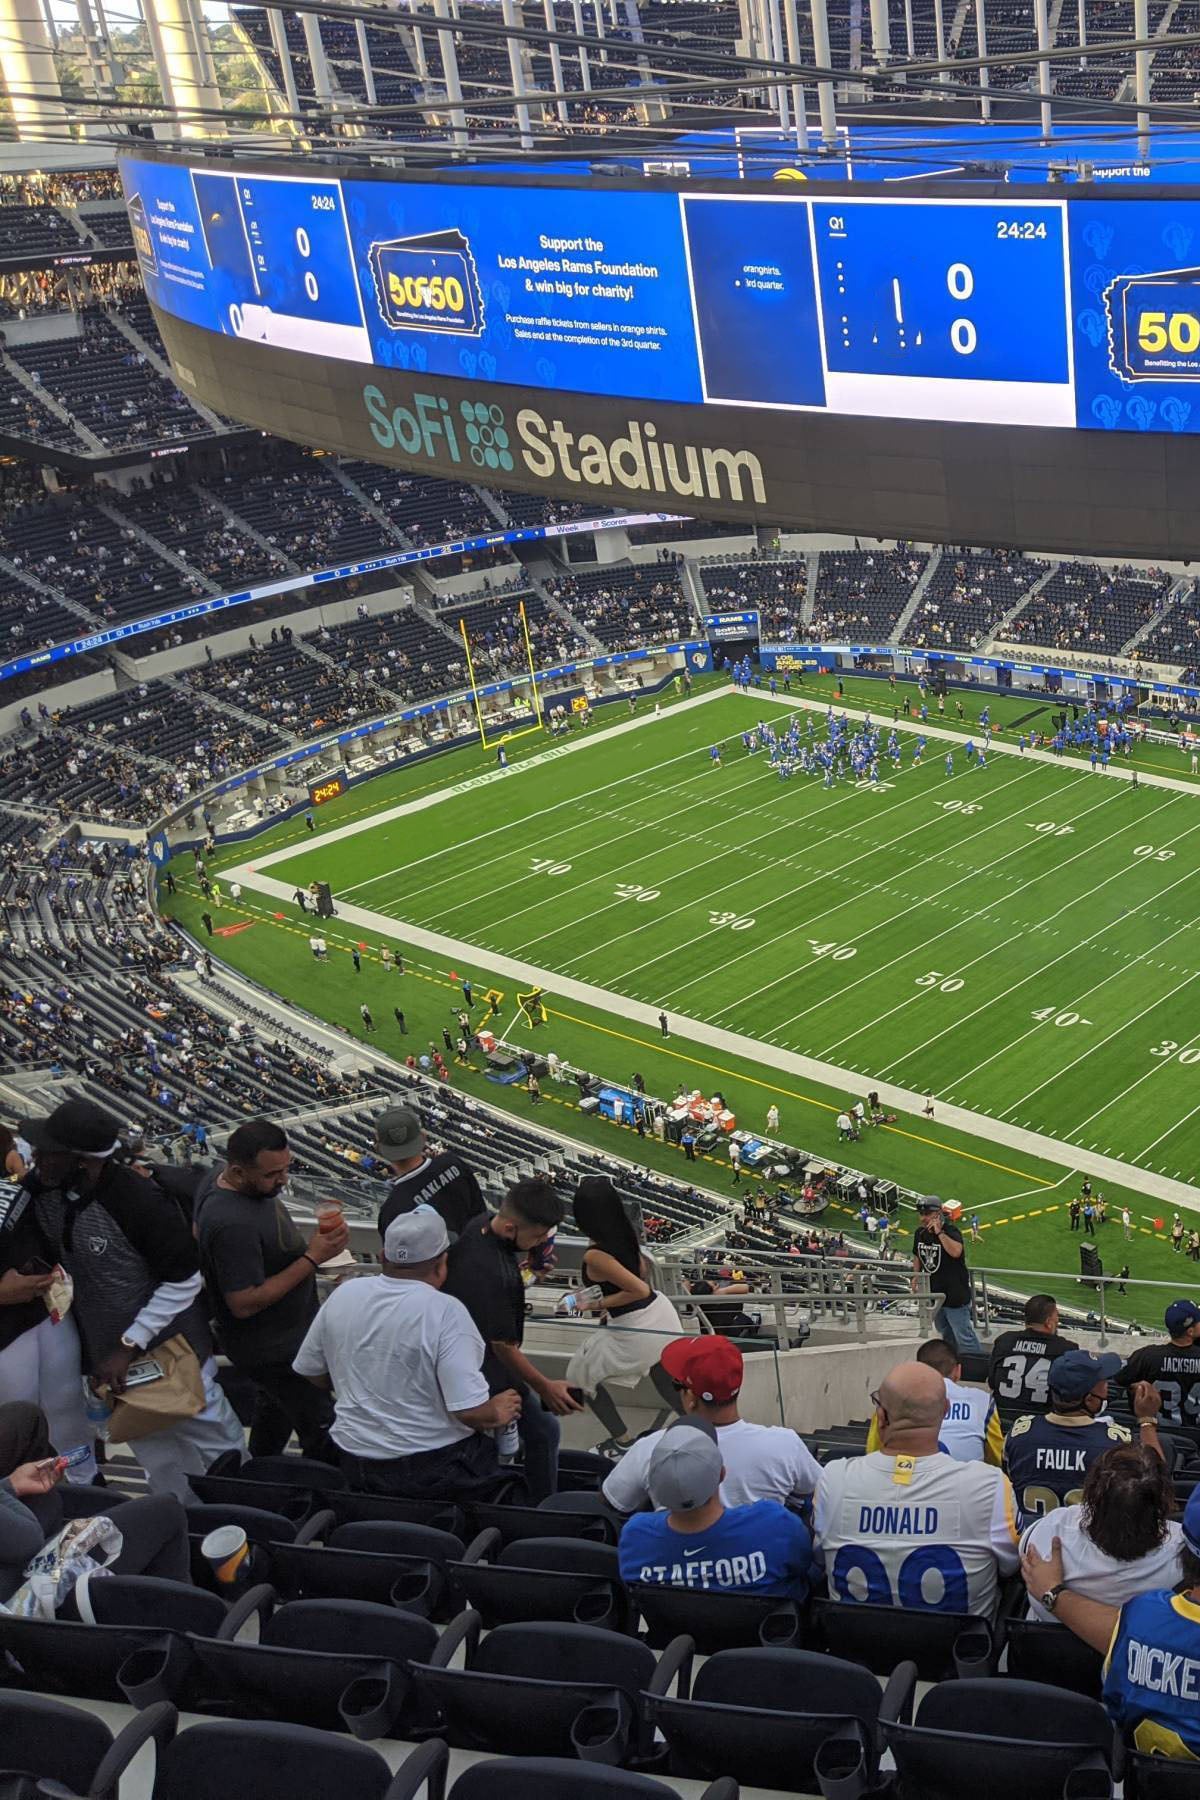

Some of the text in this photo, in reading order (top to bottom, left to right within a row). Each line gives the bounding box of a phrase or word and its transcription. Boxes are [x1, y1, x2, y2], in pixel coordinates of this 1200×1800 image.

[311, 196, 335, 211] 24:24
[829, 216, 844, 230] Q1
[996, 221, 1047, 239] 24:24
[296, 227, 310, 257] 0
[539, 234, 604, 253] Support the
[497, 254, 658, 278] Los Angeles Rams Foundation
[304, 272, 319, 301] 0
[525, 278, 635, 301] & win big for charity!
[947, 263, 974, 301] 0
[505, 313, 668, 336] Purchase raffle tickets from sellers in orange shirts.
[1138, 312, 1200, 353] 50
[514, 329, 662, 351] Sales end at the completion of the 3rd quarter.
[950, 318, 977, 355] 0
[1144, 360, 1176, 369] Benefitting
[1177, 360, 1187, 368] the
[363, 384, 768, 504] SoFi Stadium
[556, 518, 628, 534] Week Scores
[719, 615, 744, 623] RAMS
[81, 636, 103, 649] 24:24
[573, 699, 586, 710] 25
[315, 782, 340, 802] 24:24
[854, 780, 897, 793] 20
[942, 800, 984, 815] 30
[1035, 821, 1076, 836] 40
[1132, 844, 1176, 862] 50
[532, 858, 572, 876] 10
[617, 884, 661, 903] 20
[709, 911, 756, 931] 30
[812, 941, 858, 961] 40
[914, 971, 965, 993] 50
[1030, 1005, 1079, 1028] 40
[413, 1165, 461, 1206] OAKLAND
[1012, 1340, 1047, 1356] JACKSON
[1160, 1356, 1200, 1374] JACKSON
[999, 1355, 1051, 1403] 34
[1036, 1448, 1086, 1472] FAULK
[859, 1506, 938, 1536] DONALD
[639, 1551, 767, 1589] STAFFORD
